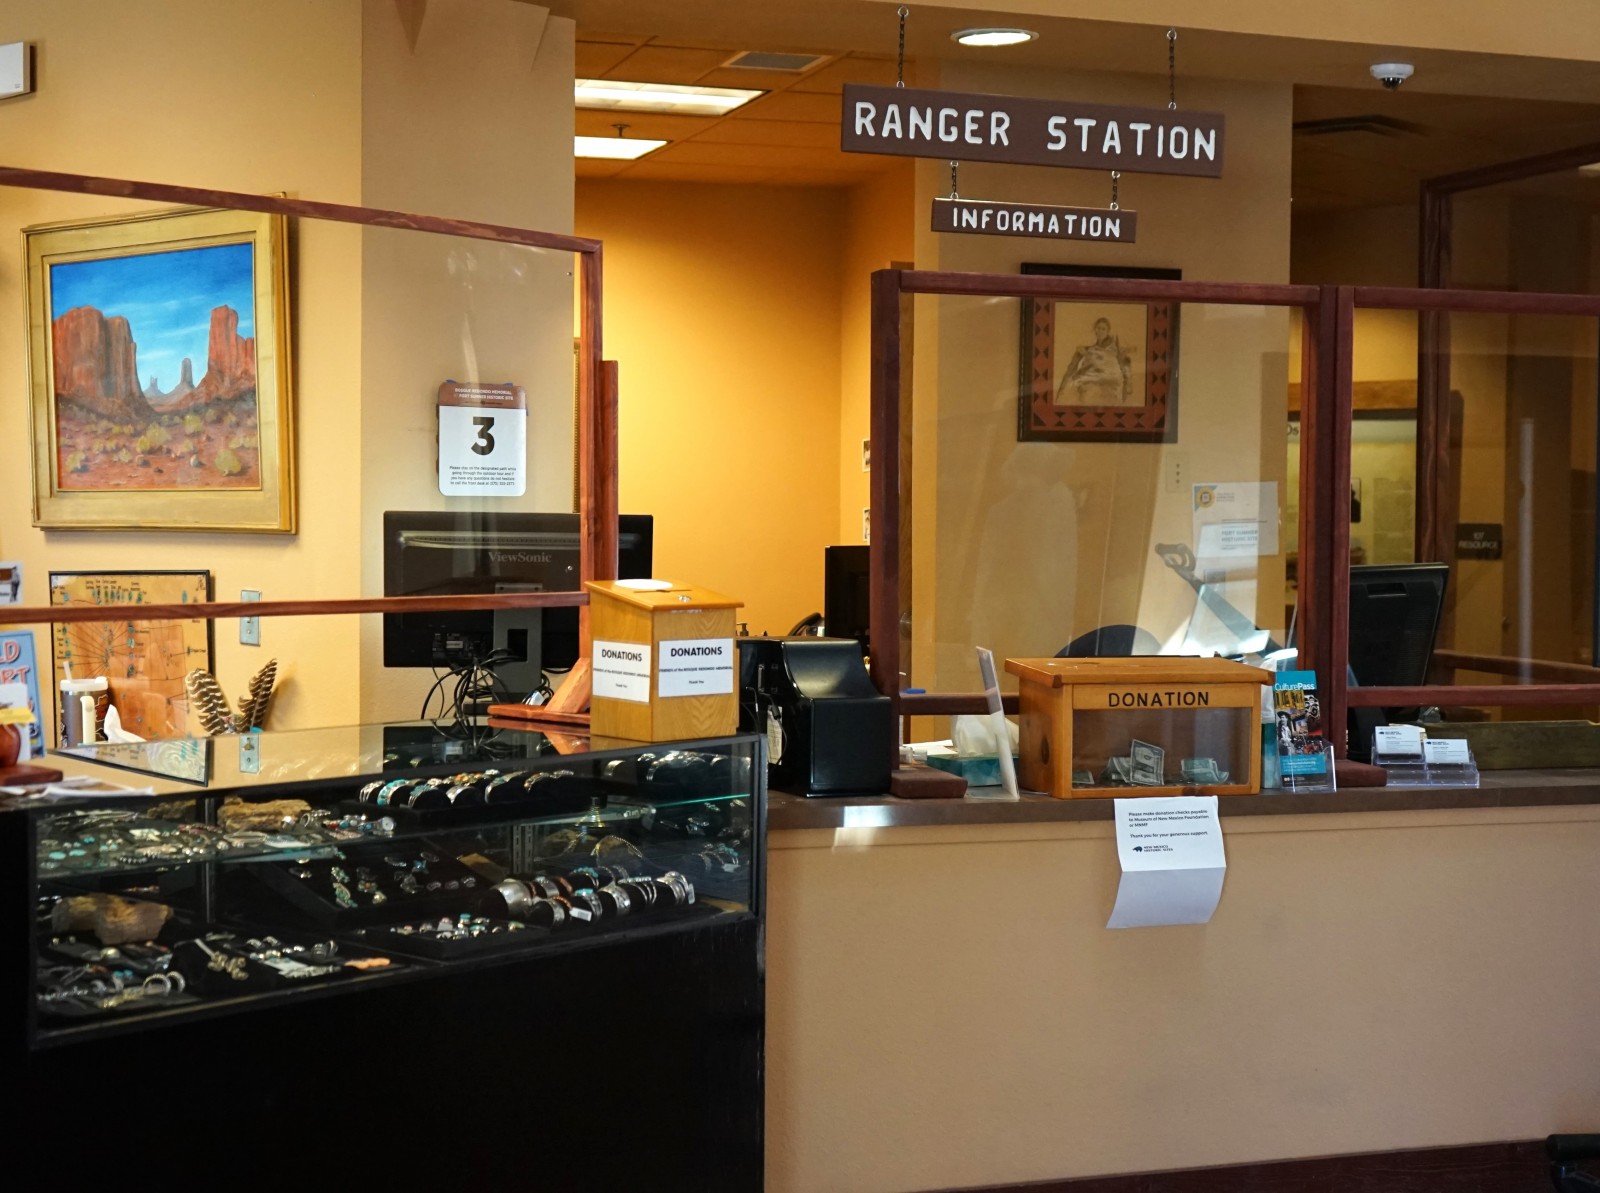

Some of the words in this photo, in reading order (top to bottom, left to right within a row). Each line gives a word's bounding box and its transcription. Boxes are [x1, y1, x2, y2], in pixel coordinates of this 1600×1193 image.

[855, 101, 1010, 146] RANGER
[1047, 115, 1216, 161] STATION
[952, 207, 1120, 238] INFORMATION
[471, 416, 495, 456] 3
[1458, 540, 1498, 550] RESOURCE
[488, 551, 552, 562] ViewSonic
[602, 649, 642, 662] DONATIONS
[670, 647, 722, 657] DONATIONS
[1274, 682, 1315, 690] CulturePass
[1108, 691, 1208, 707] DONATION
